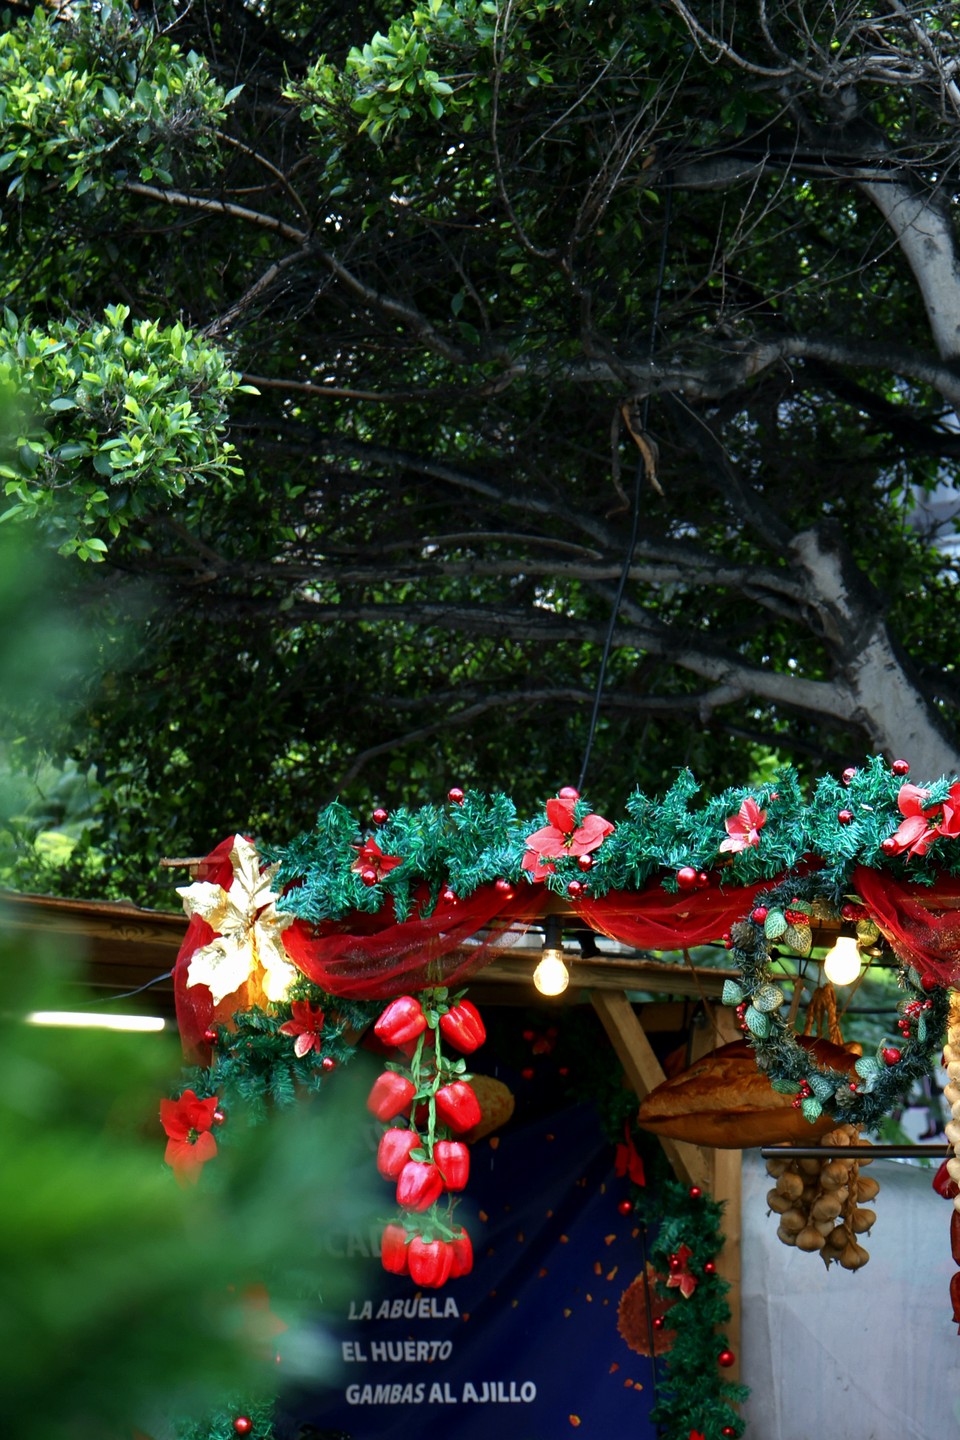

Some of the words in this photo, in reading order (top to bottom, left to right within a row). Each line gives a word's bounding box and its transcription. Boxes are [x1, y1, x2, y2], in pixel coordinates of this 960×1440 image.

[348, 1300, 373, 1321] LA
[376, 1297, 460, 1320] ABUELA
[342, 1341, 368, 1362] EL
[371, 1340, 453, 1362] HUERTO
[345, 1383, 425, 1405] GAMBAS
[428, 1383, 458, 1404] AL
[462, 1381, 538, 1403] AJILLO
